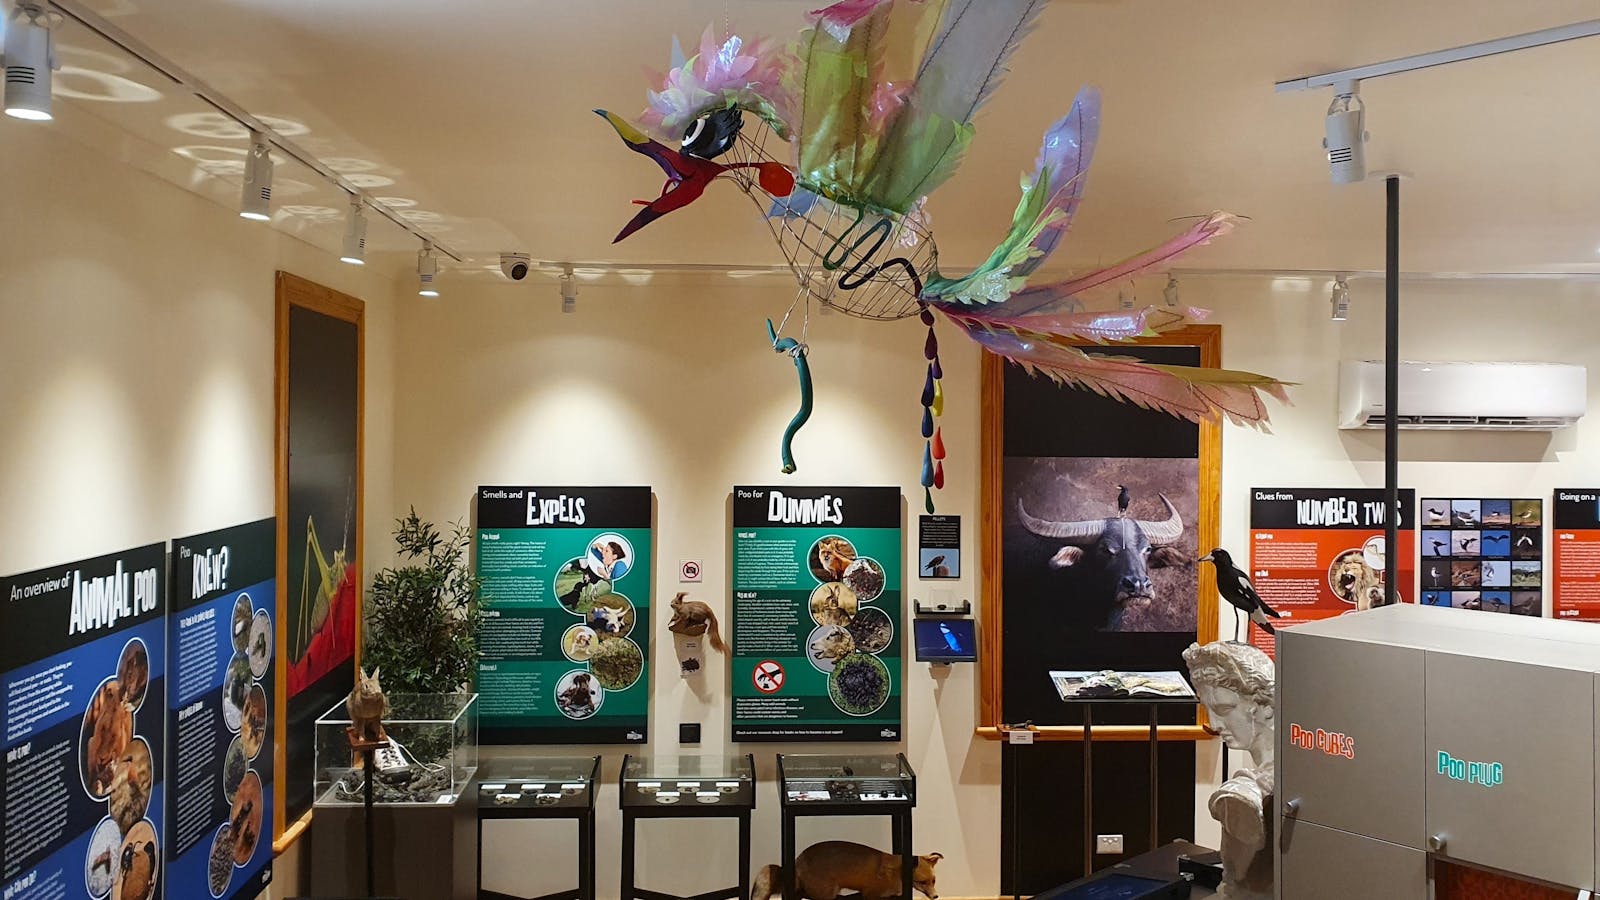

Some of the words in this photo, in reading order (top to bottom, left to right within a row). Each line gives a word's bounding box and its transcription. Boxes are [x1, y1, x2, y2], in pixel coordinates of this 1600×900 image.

[482, 490, 508, 499] Smells
[508, 490, 523, 499] and
[738, 490, 752, 499] Poo
[752, 490, 764, 499] for
[1255, 492, 1275, 501] Clues
[1275, 492, 1294, 501] from
[1560, 492, 1580, 503] Going
[1296, 496, 1359, 527] NUMBER
[1363, 499, 1403, 527] TWS
[180, 545, 191, 560] Poo
[192, 546, 229, 600] KNEW?
[10, 584, 23, 602] An
[24, 577, 64, 598] overview
[61, 571, 71, 589] of
[69, 559, 132, 636] ANIMAL
[133, 567, 157, 617] POO
[1316, 728, 1355, 760] CUBES
[1468, 761, 1503, 787] PLUG
